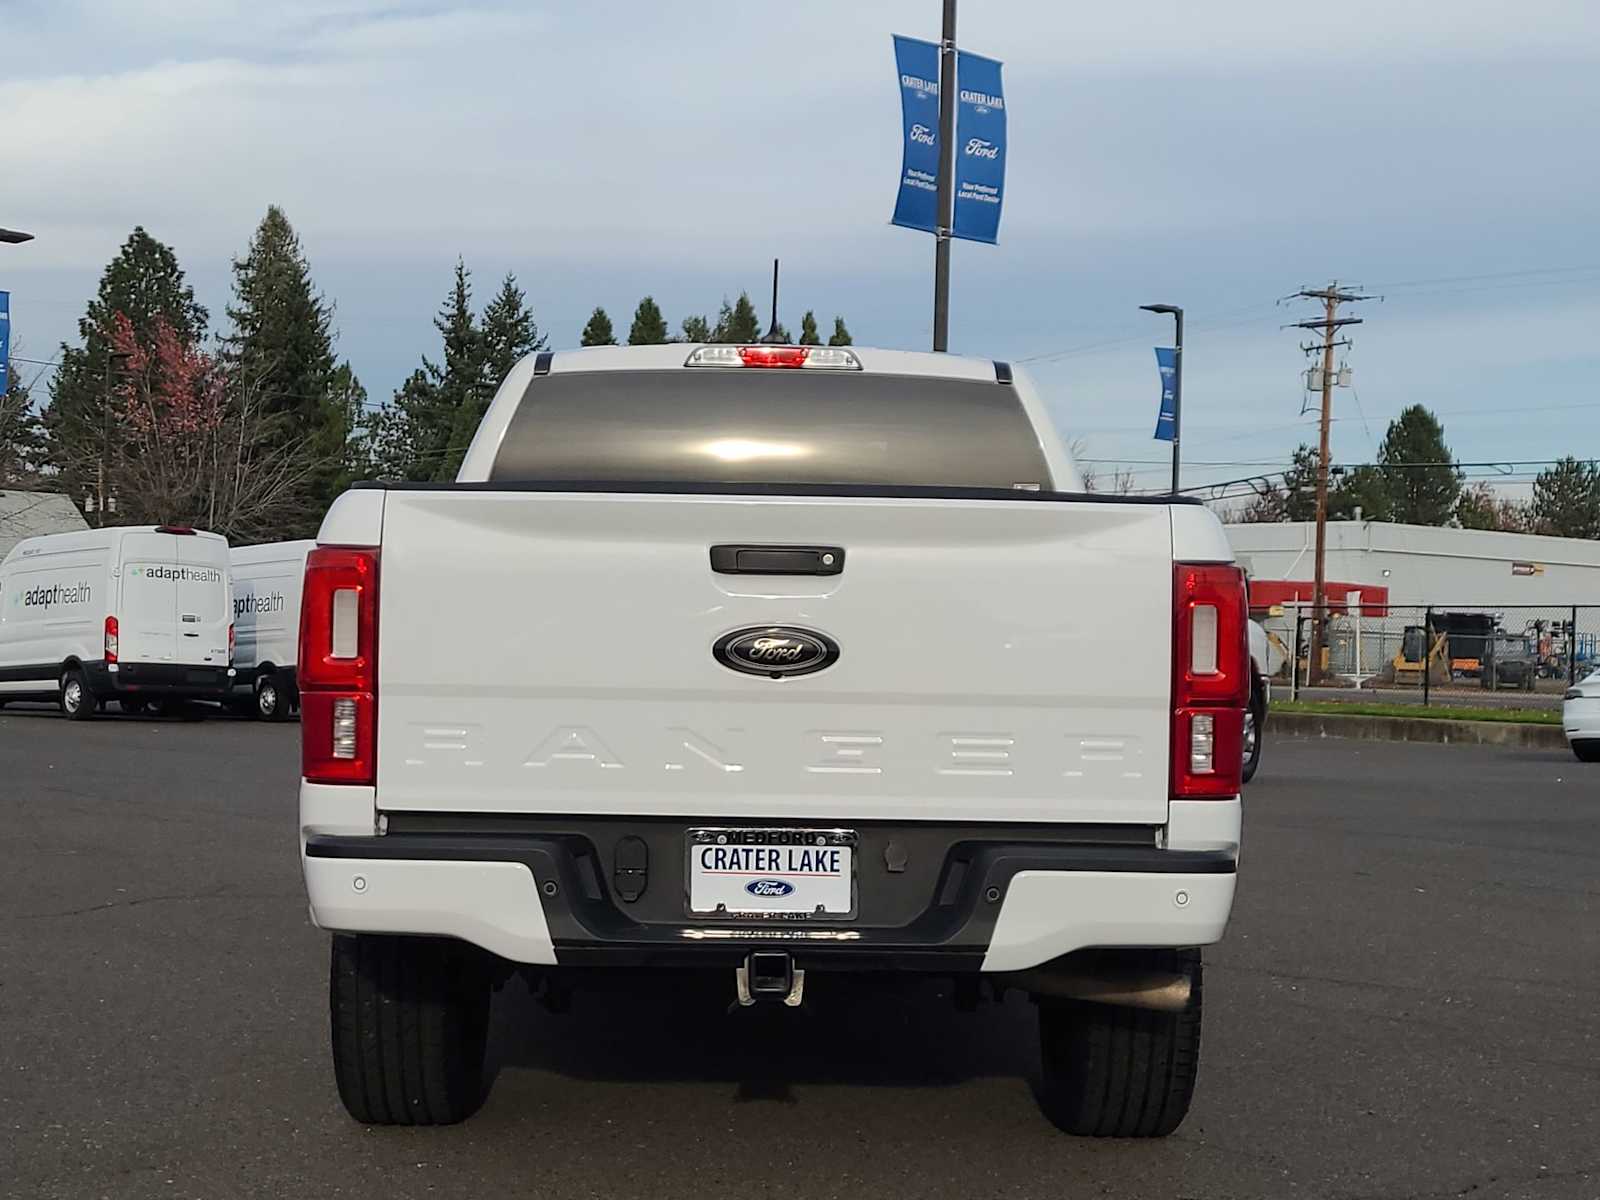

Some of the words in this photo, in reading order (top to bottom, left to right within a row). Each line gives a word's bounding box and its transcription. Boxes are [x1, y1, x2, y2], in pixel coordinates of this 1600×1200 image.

[902, 75, 924, 90] CRATER
[924, 80, 938, 96] LAKE
[960, 90, 986, 106] CRATER
[986, 95, 1003, 110] LAKE
[910, 124, 935, 145] Ford
[965, 138, 999, 159] Ford
[146, 566, 220, 583] adapthealth
[25, 581, 91, 610] adapthealth
[233, 592, 284, 618] apthealth
[749, 638, 804, 660] Ford
[404, 722, 1144, 776] RANGER
[701, 848, 780, 871] CRATER
[788, 849, 841, 873] LAKE
[754, 880, 785, 896] Ford
